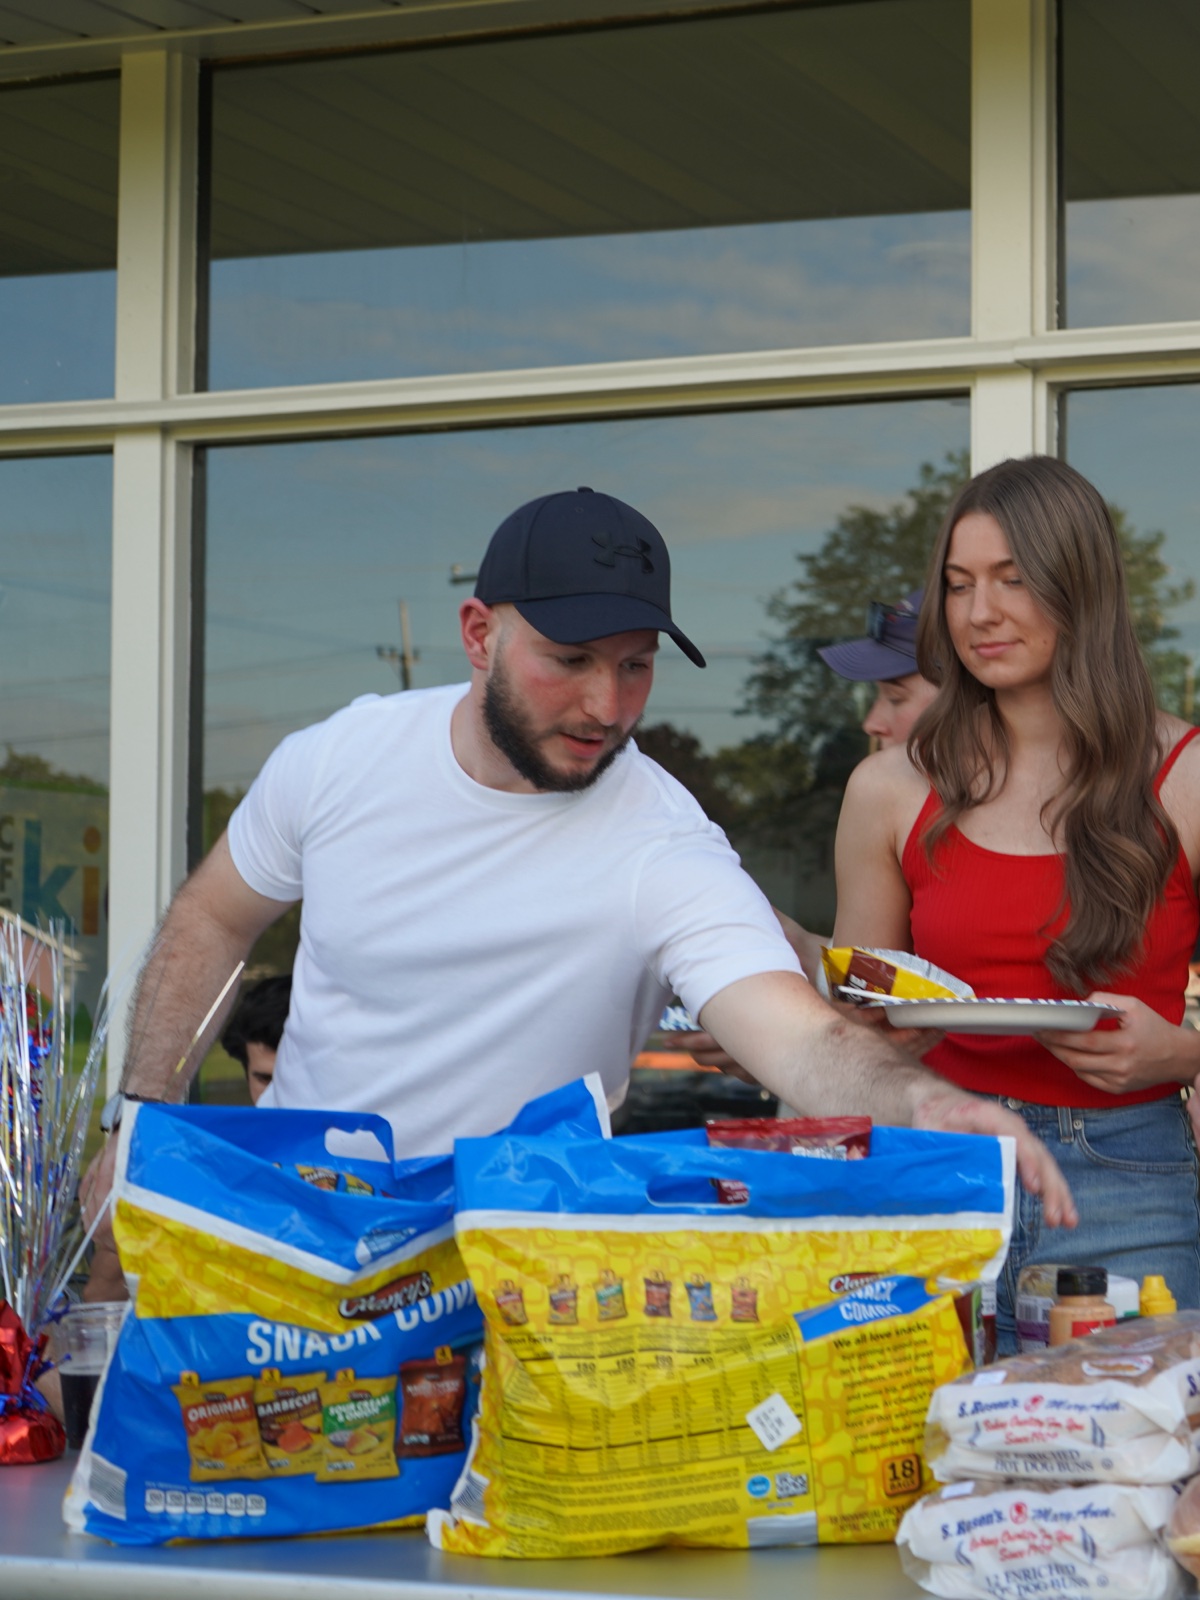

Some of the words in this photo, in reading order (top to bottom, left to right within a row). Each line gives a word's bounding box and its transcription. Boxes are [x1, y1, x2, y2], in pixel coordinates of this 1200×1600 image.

[829, 1272, 886, 1293] Clan
[833, 1339, 852, 1349] We
[854, 1333, 868, 1344] all
[869, 1331, 892, 1342] love
[187, 1396, 249, 1422] ORIGINAL
[257, 1390, 318, 1417] BARBECUE
[888, 1458, 915, 1482] 18
[1023, 1459, 1054, 1473] DOG
[1055, 1460, 1094, 1473] BUNS
[889, 1480, 915, 1491] BAGS
[955, 1508, 1006, 1536] Rosen's
[1004, 1564, 1077, 1585] ENRICHED
[1016, 1582, 1049, 1597] DOG
[1049, 1576, 1091, 1592] BUNS
